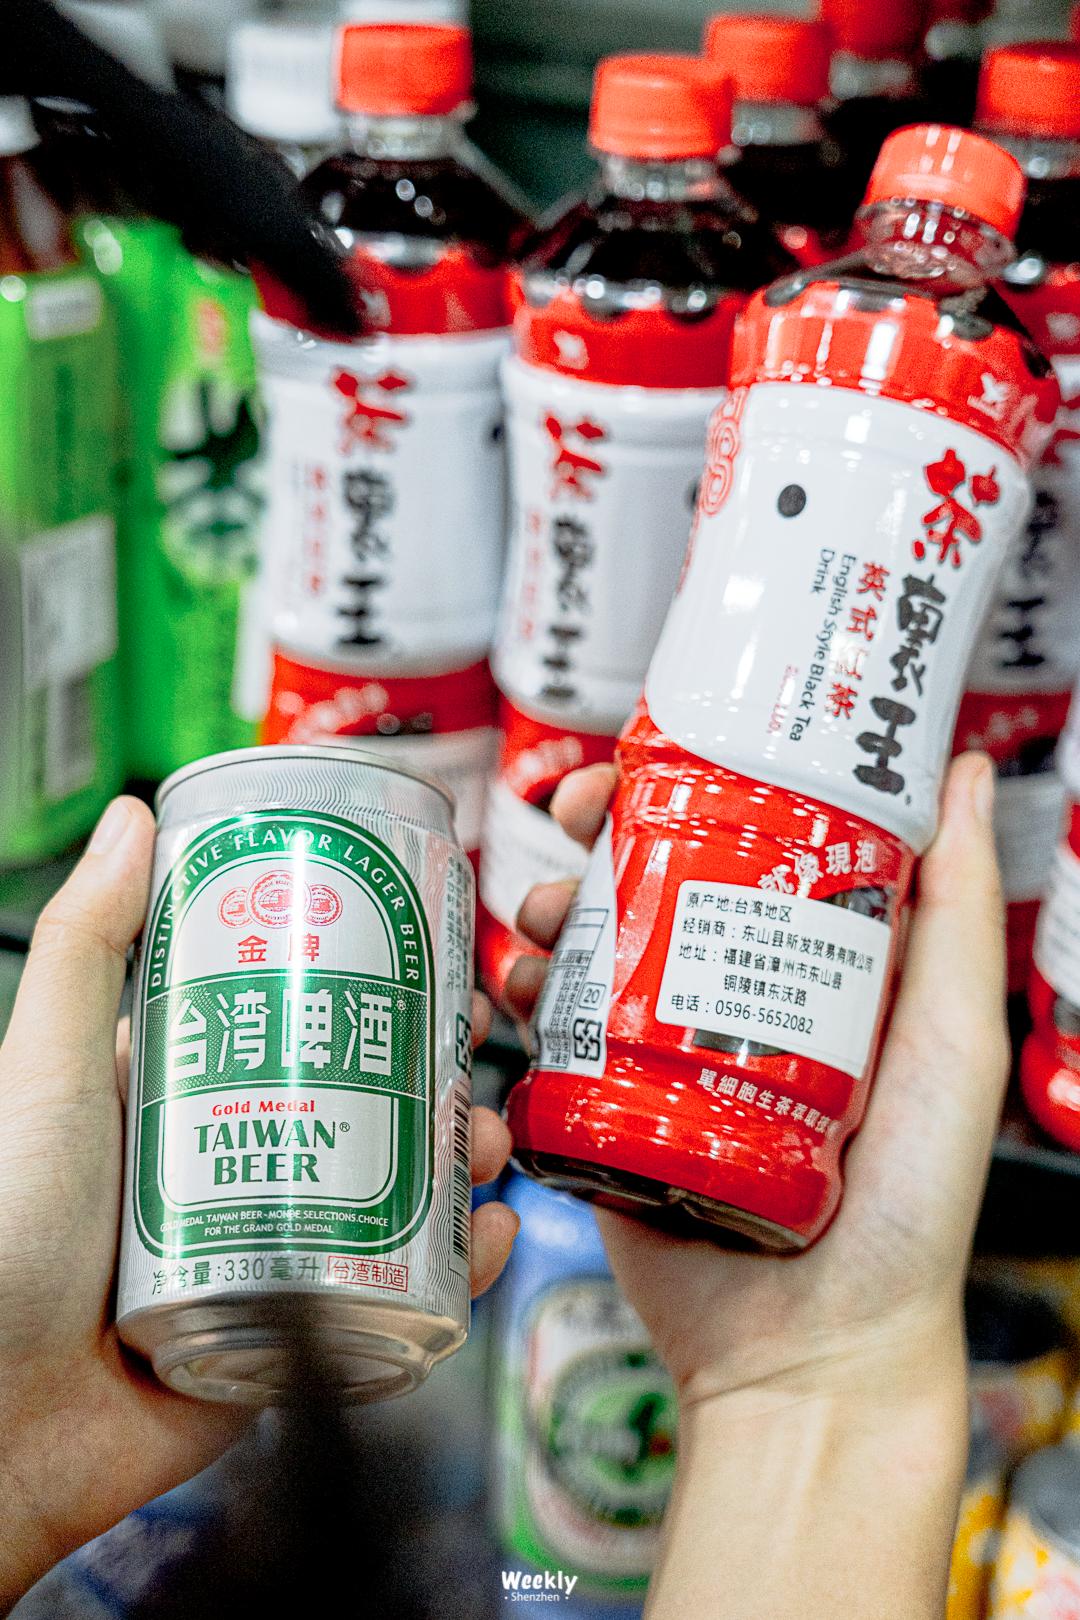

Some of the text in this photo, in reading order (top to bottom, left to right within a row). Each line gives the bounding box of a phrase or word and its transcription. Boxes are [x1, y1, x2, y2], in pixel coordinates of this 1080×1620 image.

[810, 548, 836, 595] Drink
[789, 552, 857, 742] English Style Black Tea
[151, 843, 224, 987] DISTINCTIVE
[233, 829, 333, 852] FLAVOR
[343, 844, 406, 912] LAGER
[399, 922, 420, 982] BEER
[684, 891, 794, 924] 原产地:台湾地区
[582, 986, 601, 1005] 20
[211, 1102, 251, 1117] Gold
[212, 1154, 321, 1186] BEER
[204, 1222, 335, 1237] FOR THE GRAND GOLD MEDAL
[206, 1211, 239, 1224] TAIWAN
[331, 1260, 407, 1288] 台湾制造
